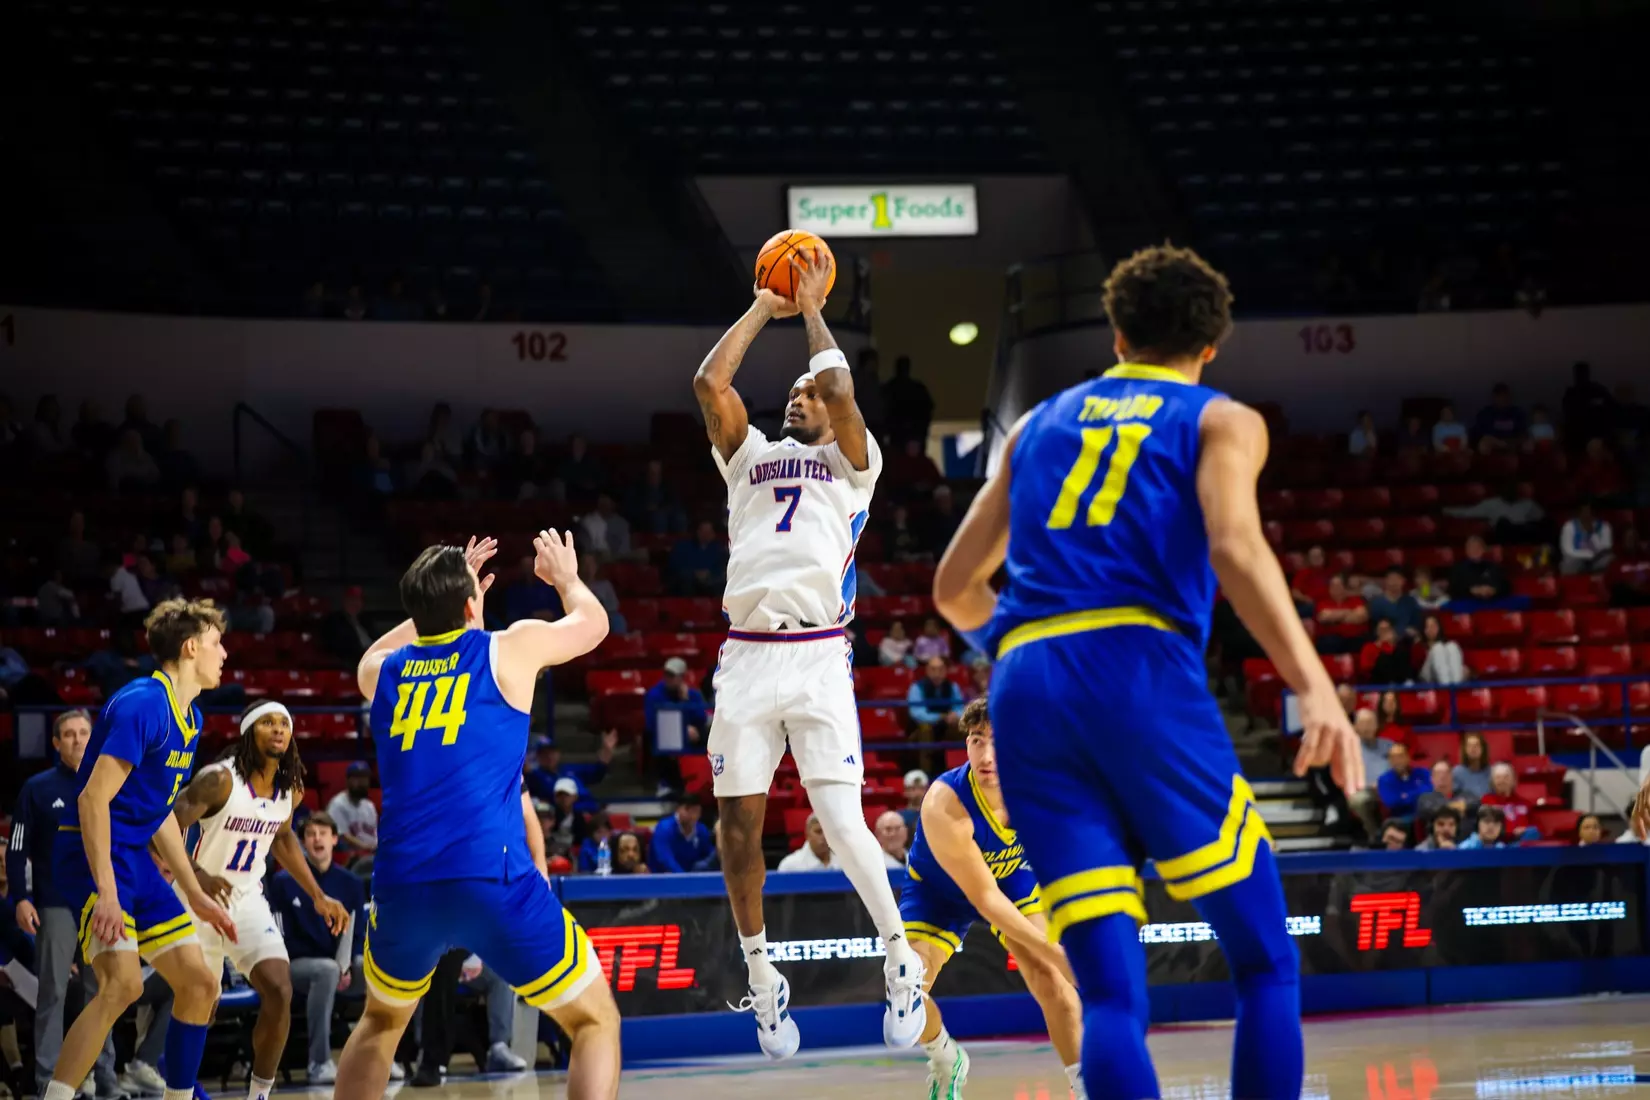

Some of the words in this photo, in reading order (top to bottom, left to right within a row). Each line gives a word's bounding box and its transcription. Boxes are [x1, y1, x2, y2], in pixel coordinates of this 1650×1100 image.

[798, 197, 868, 226] Super
[870, 191, 893, 229] 1
[894, 197, 965, 220] Foods
[510, 330, 568, 362] 102
[1297, 323, 1356, 355] 103
[749, 457, 801, 486] LOUISIANA
[804, 459, 833, 483] TECH
[1046, 422, 1152, 529] 11
[773, 484, 803, 532] 7
[401, 651, 460, 678] HOUSER
[389, 673, 471, 752] 44
[166, 773, 183, 806] 5
[223, 815, 265, 834] LOUISIANA
[225, 839, 258, 872] 11
[1350, 891, 1432, 950] TFL
[586, 924, 695, 992] TFL
